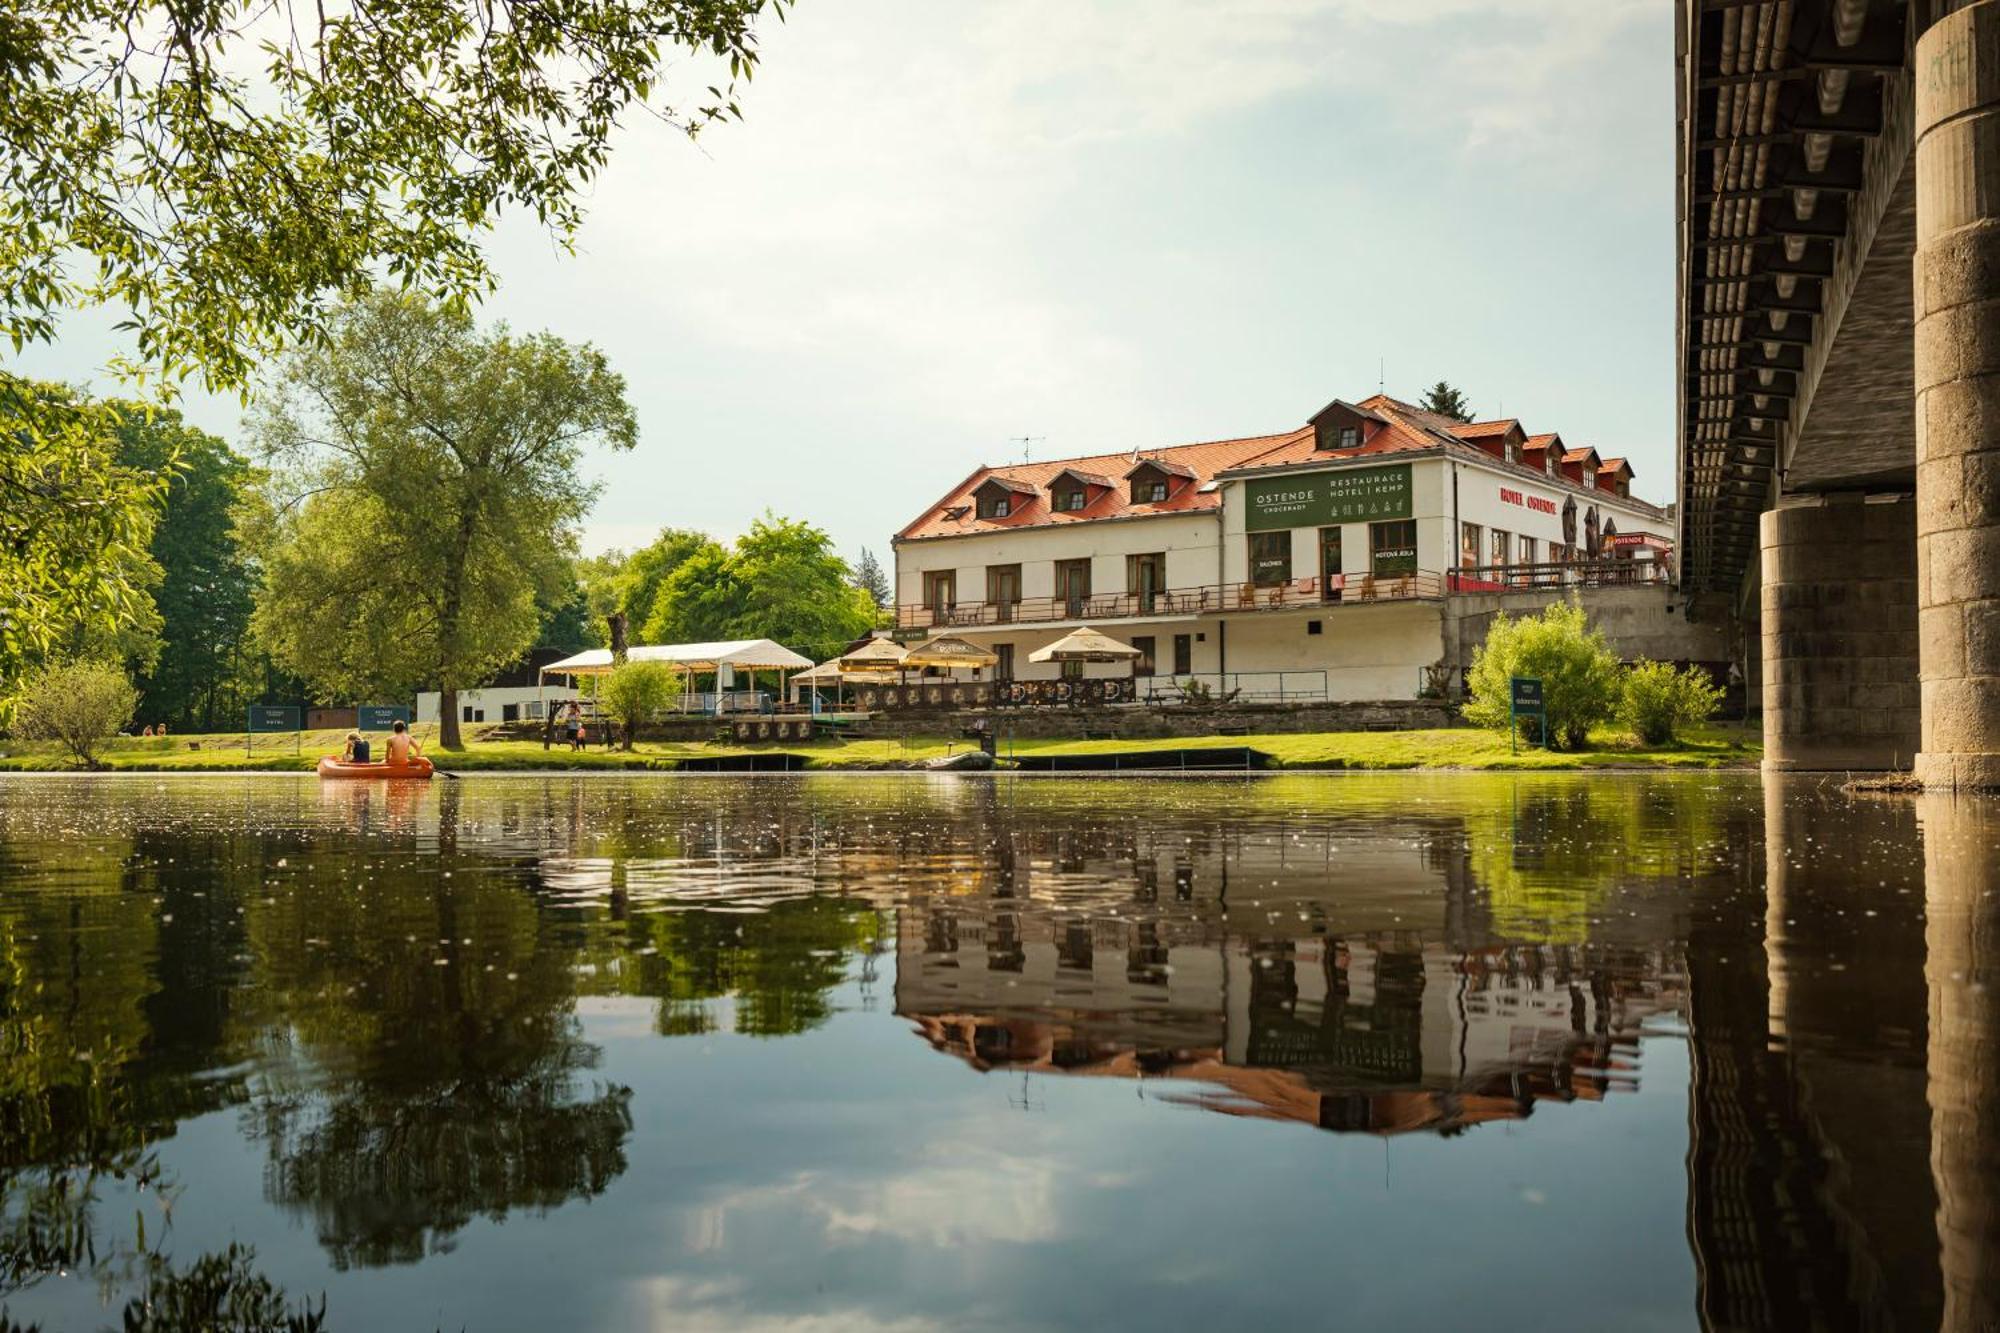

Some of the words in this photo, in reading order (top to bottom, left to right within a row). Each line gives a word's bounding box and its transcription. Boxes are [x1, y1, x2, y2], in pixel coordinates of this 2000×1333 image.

[1330, 474, 1403, 487] RESTAURACE
[1256, 490, 1314, 503] OSTENDE
[1330, 489, 1363, 497] HOTEL
[1375, 484, 1404, 493] KEMP
[1500, 487, 1524, 506] HOTEL
[1527, 496, 1557, 515] OSTENDE
